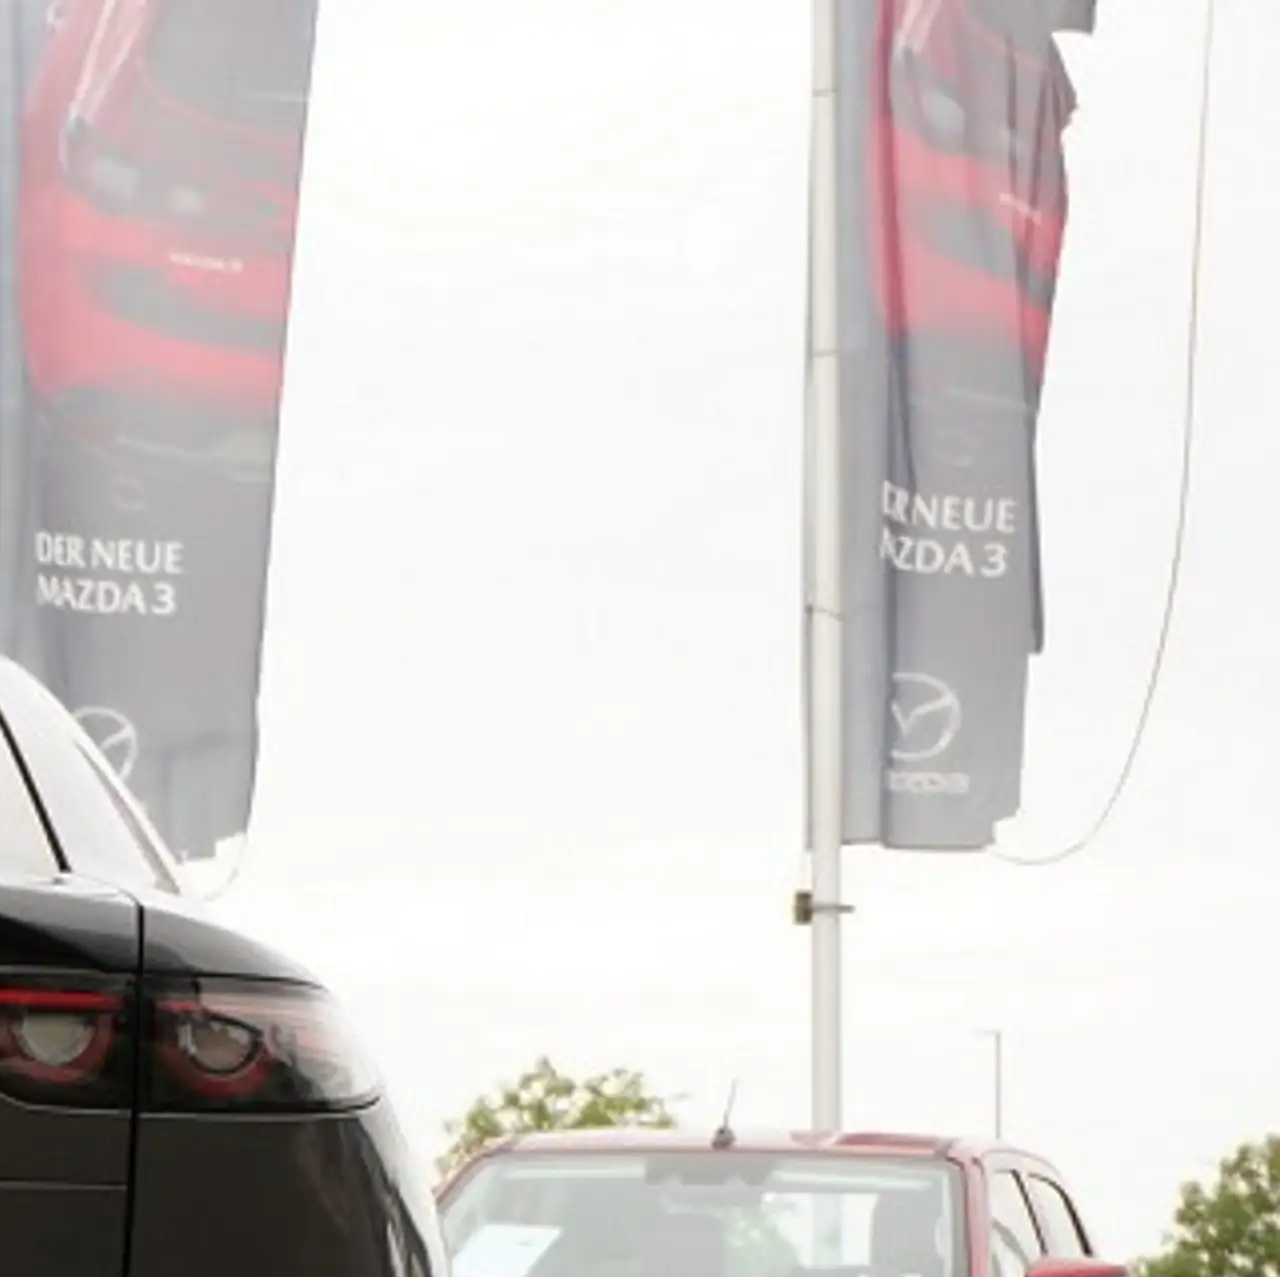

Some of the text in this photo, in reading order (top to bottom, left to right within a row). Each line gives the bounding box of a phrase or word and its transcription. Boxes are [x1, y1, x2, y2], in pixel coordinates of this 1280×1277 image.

[913, 493, 1017, 534] NEUE
[35, 529, 184, 575] DER NEUE
[878, 527, 1008, 578] AZDA 3
[36, 573, 177, 616] MAZDA 3
